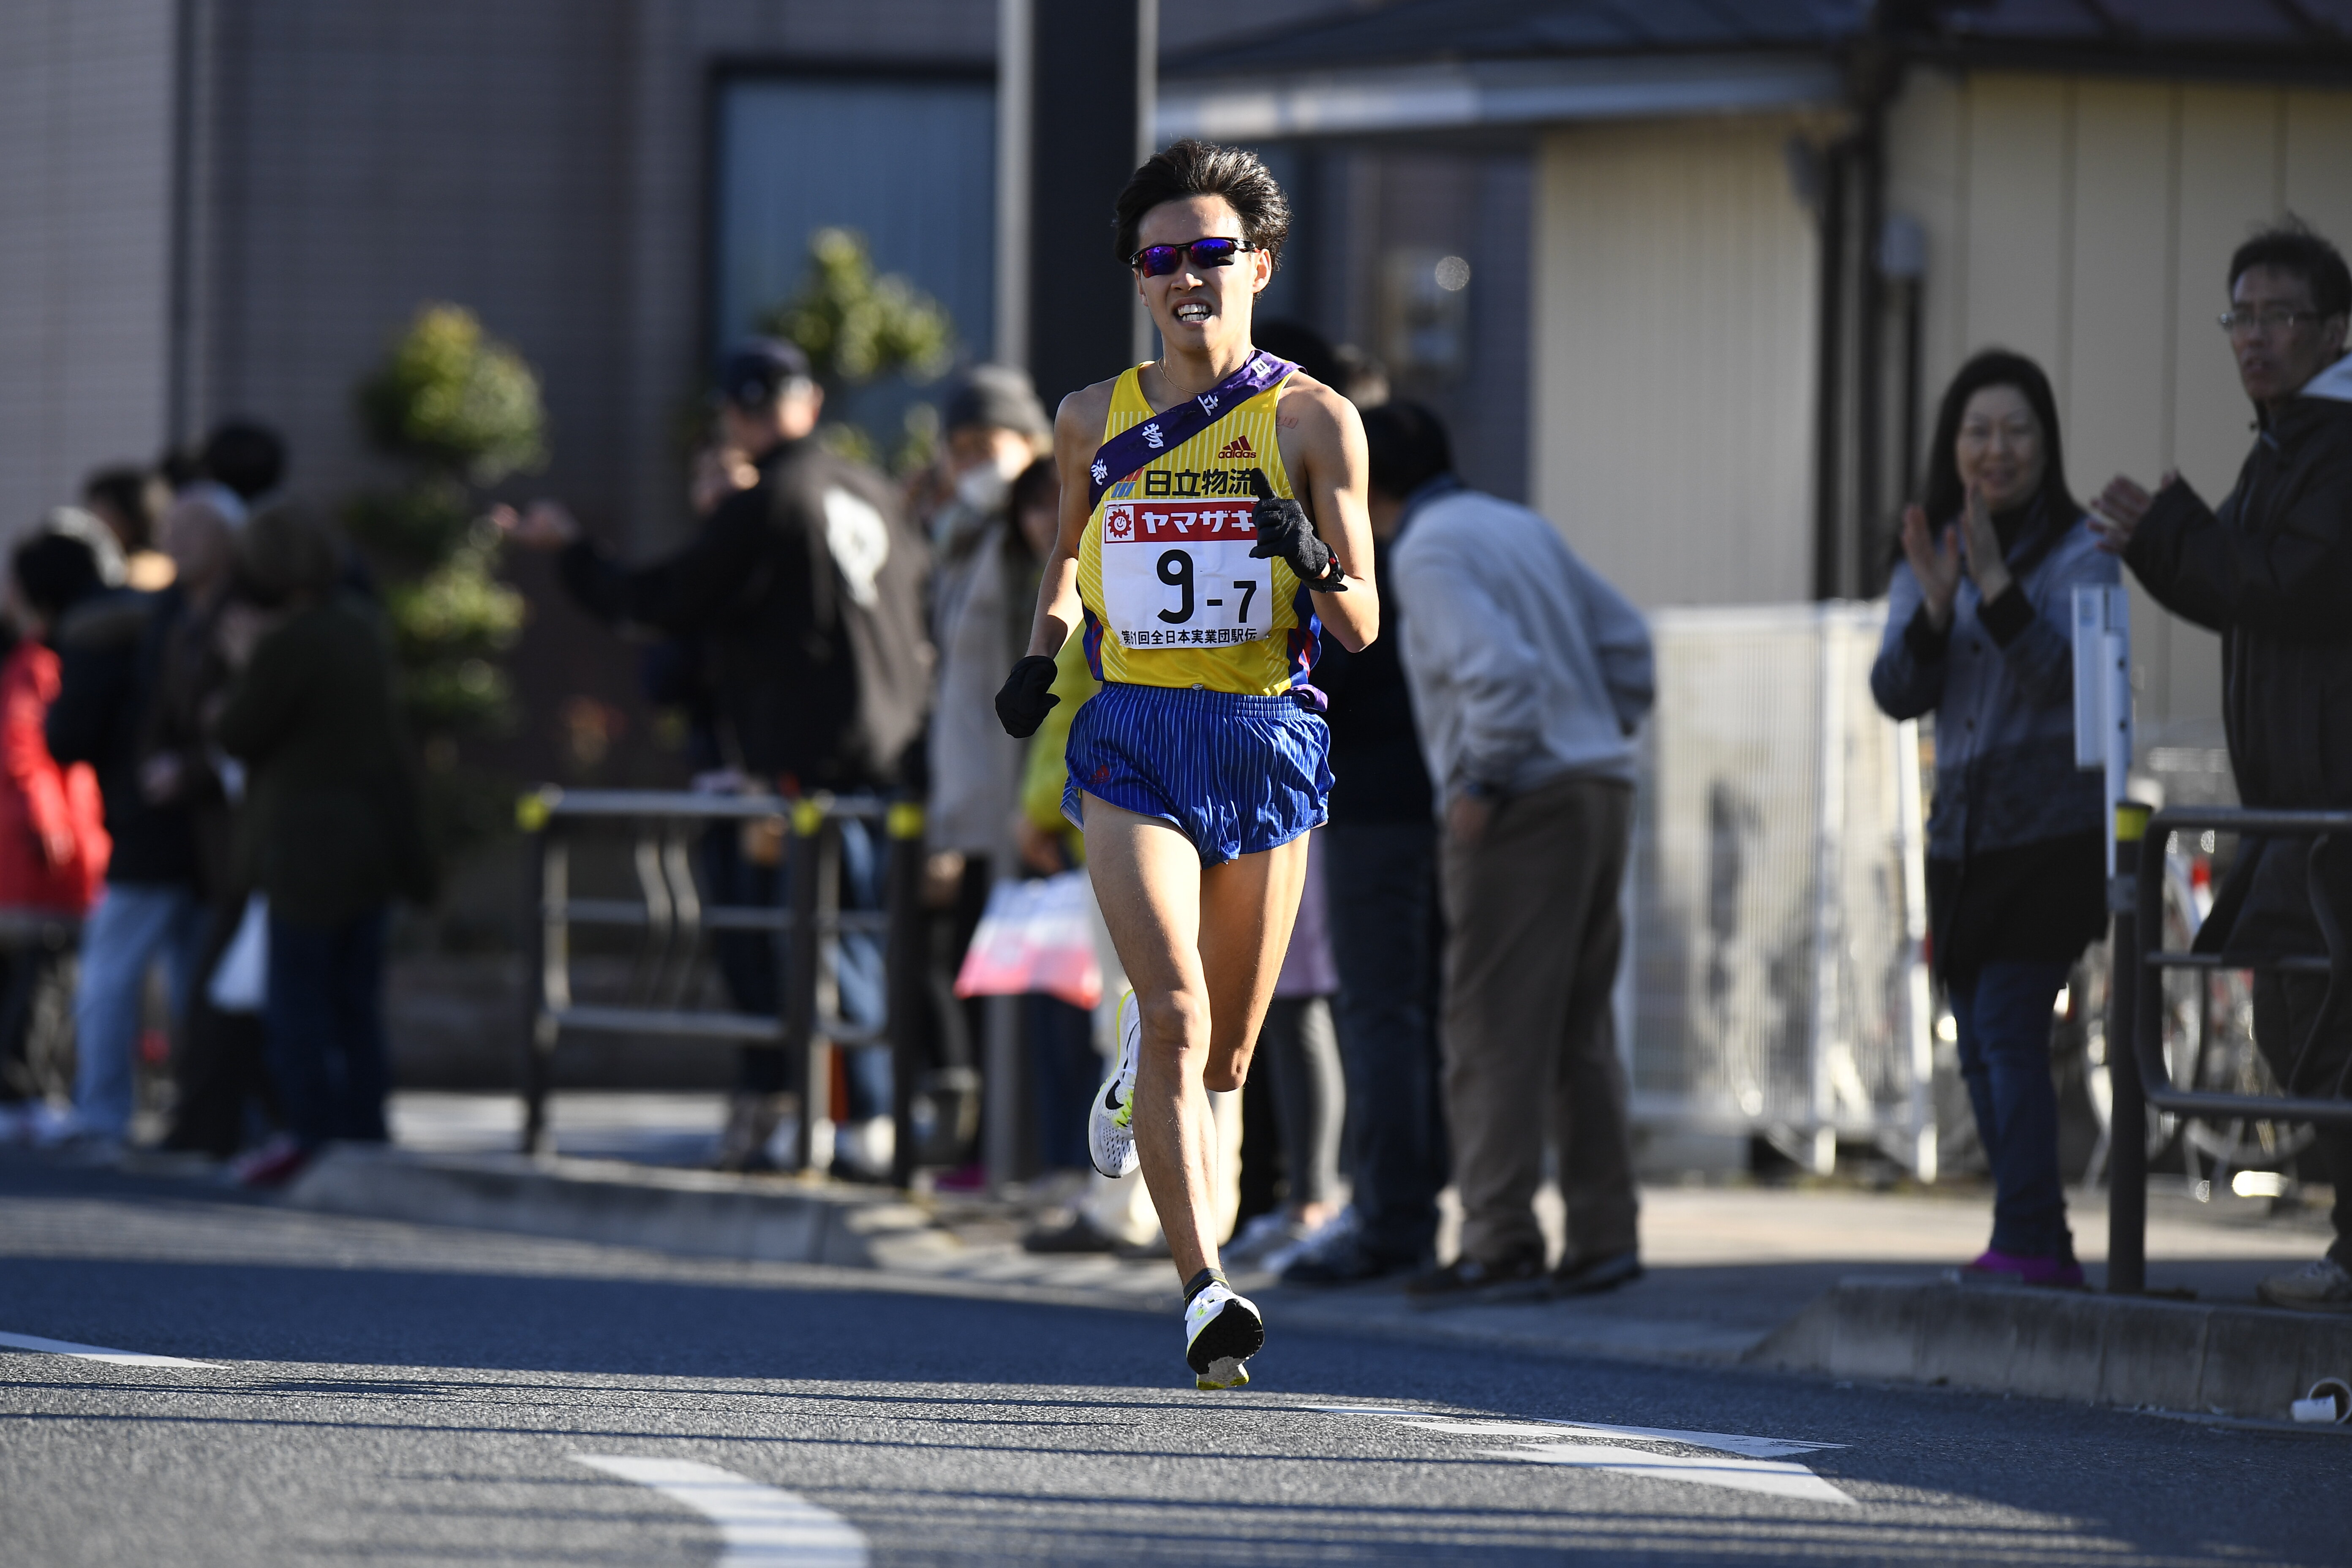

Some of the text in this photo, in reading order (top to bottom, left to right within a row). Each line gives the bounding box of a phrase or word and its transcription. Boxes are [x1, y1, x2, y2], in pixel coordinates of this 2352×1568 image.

[1218, 449, 1257, 459] adidas
[1145, 468, 1258, 496] 日立物流
[1141, 510, 1256, 534] ヤマザキ
[1121, 628, 1257, 645] 第61回全日本実業団駅伝
